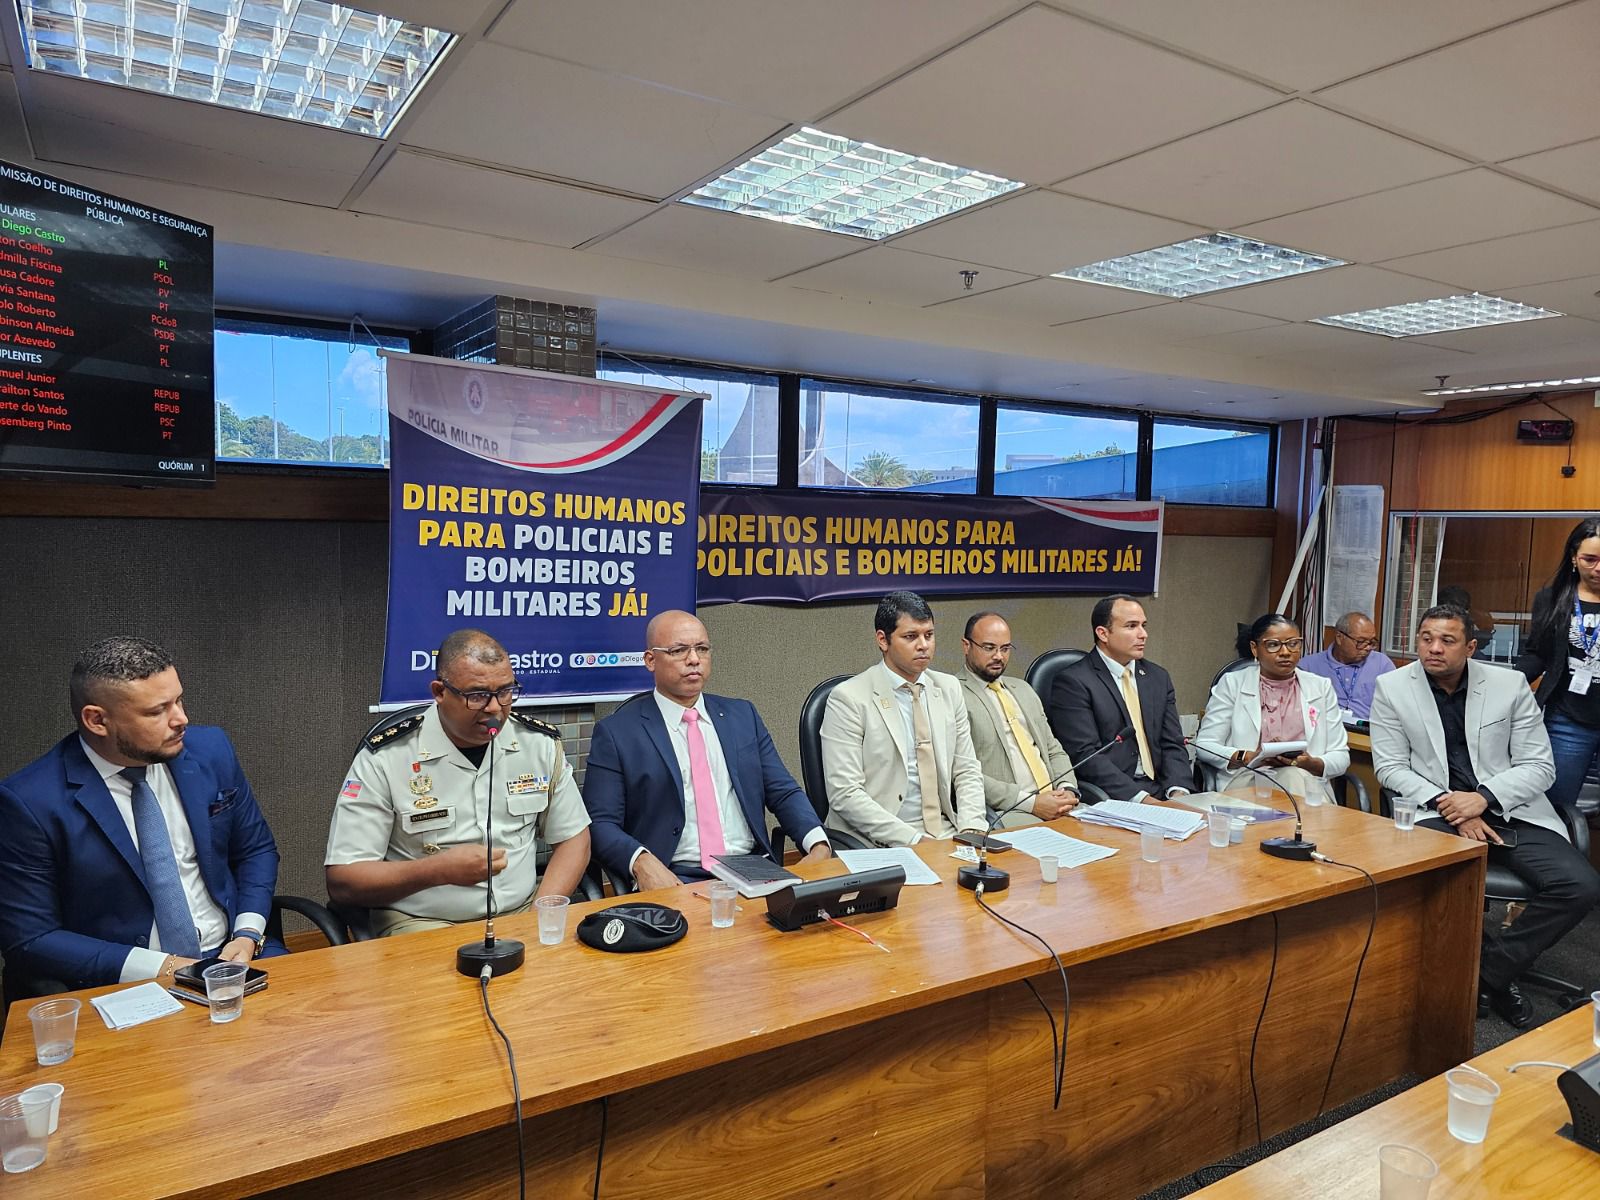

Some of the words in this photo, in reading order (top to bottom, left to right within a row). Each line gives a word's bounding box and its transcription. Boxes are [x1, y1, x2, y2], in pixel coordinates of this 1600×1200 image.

[0, 165, 42, 187] MISSÃO
[43, 179, 58, 192] DE
[59, 183, 102, 205] DIREITOS
[103, 197, 151, 220] HUMANOS
[152, 212, 158, 223] E
[159, 215, 208, 238] SEGURANÇA
[0, 203, 37, 221] ULARES
[86, 206, 125, 227] PÚBLICA
[2, 218, 33, 235] Diego
[34, 228, 66, 243] Castro
[18, 239, 54, 256] Coelho
[0, 250, 28, 265] dmilla
[30, 257, 63, 274] Fiscina
[159, 260, 169, 270] PL
[0, 269, 17, 279] usa
[20, 271, 55, 287] Cadore
[153, 272, 175, 285] PSOL
[0, 283, 14, 294] via
[16, 286, 56, 303] Santana
[158, 288, 170, 298] PV
[16, 302, 56, 318] Roberto
[159, 303, 169, 312] PT
[0, 314, 33, 329] binson
[35, 321, 75, 337] Almeida
[151, 314, 177, 328] PCdoB
[14, 333, 56, 349] Azevedo
[154, 329, 175, 341] PSDB
[0, 349, 42, 363] PLENTES
[159, 344, 170, 353] PT
[160, 358, 170, 368] PL
[0, 369, 24, 380] muel
[26, 371, 57, 384] Junior
[0, 383, 31, 396] ailton
[32, 387, 65, 400] Santos
[154, 388, 180, 400] REPUB
[0, 401, 19, 411] erte
[21, 402, 35, 412] do
[37, 403, 68, 416] Vando
[154, 402, 180, 414] REPUB
[0, 417, 45, 431] semberg
[47, 419, 72, 431] Pinto
[159, 417, 175, 428] PSC
[162, 431, 173, 440] PT
[450, 425, 500, 457] MILITAR
[158, 460, 194, 472] QUÓRUM
[200, 464, 206, 472] 1
[402, 483, 546, 518] DIREITOS
[554, 493, 686, 526] HUMANOS
[418, 519, 506, 549] PARA
[514, 524, 652, 555] POLICIAIS
[658, 531, 673, 556] E
[825, 517, 949, 545] HUMANOS
[955, 520, 1016, 545] PARA
[836, 549, 850, 576] E
[857, 549, 996, 575] BOMBEIROS
[1001, 549, 1108, 574] MILITARES
[1112, 544, 1143, 572] JÁ!
[465, 556, 635, 586] BOMBEIROS
[446, 590, 601, 617] MILITARES
[608, 587, 649, 617] JÁ!
[509, 650, 563, 669] astro
[620, 655, 645, 664] @Diego
